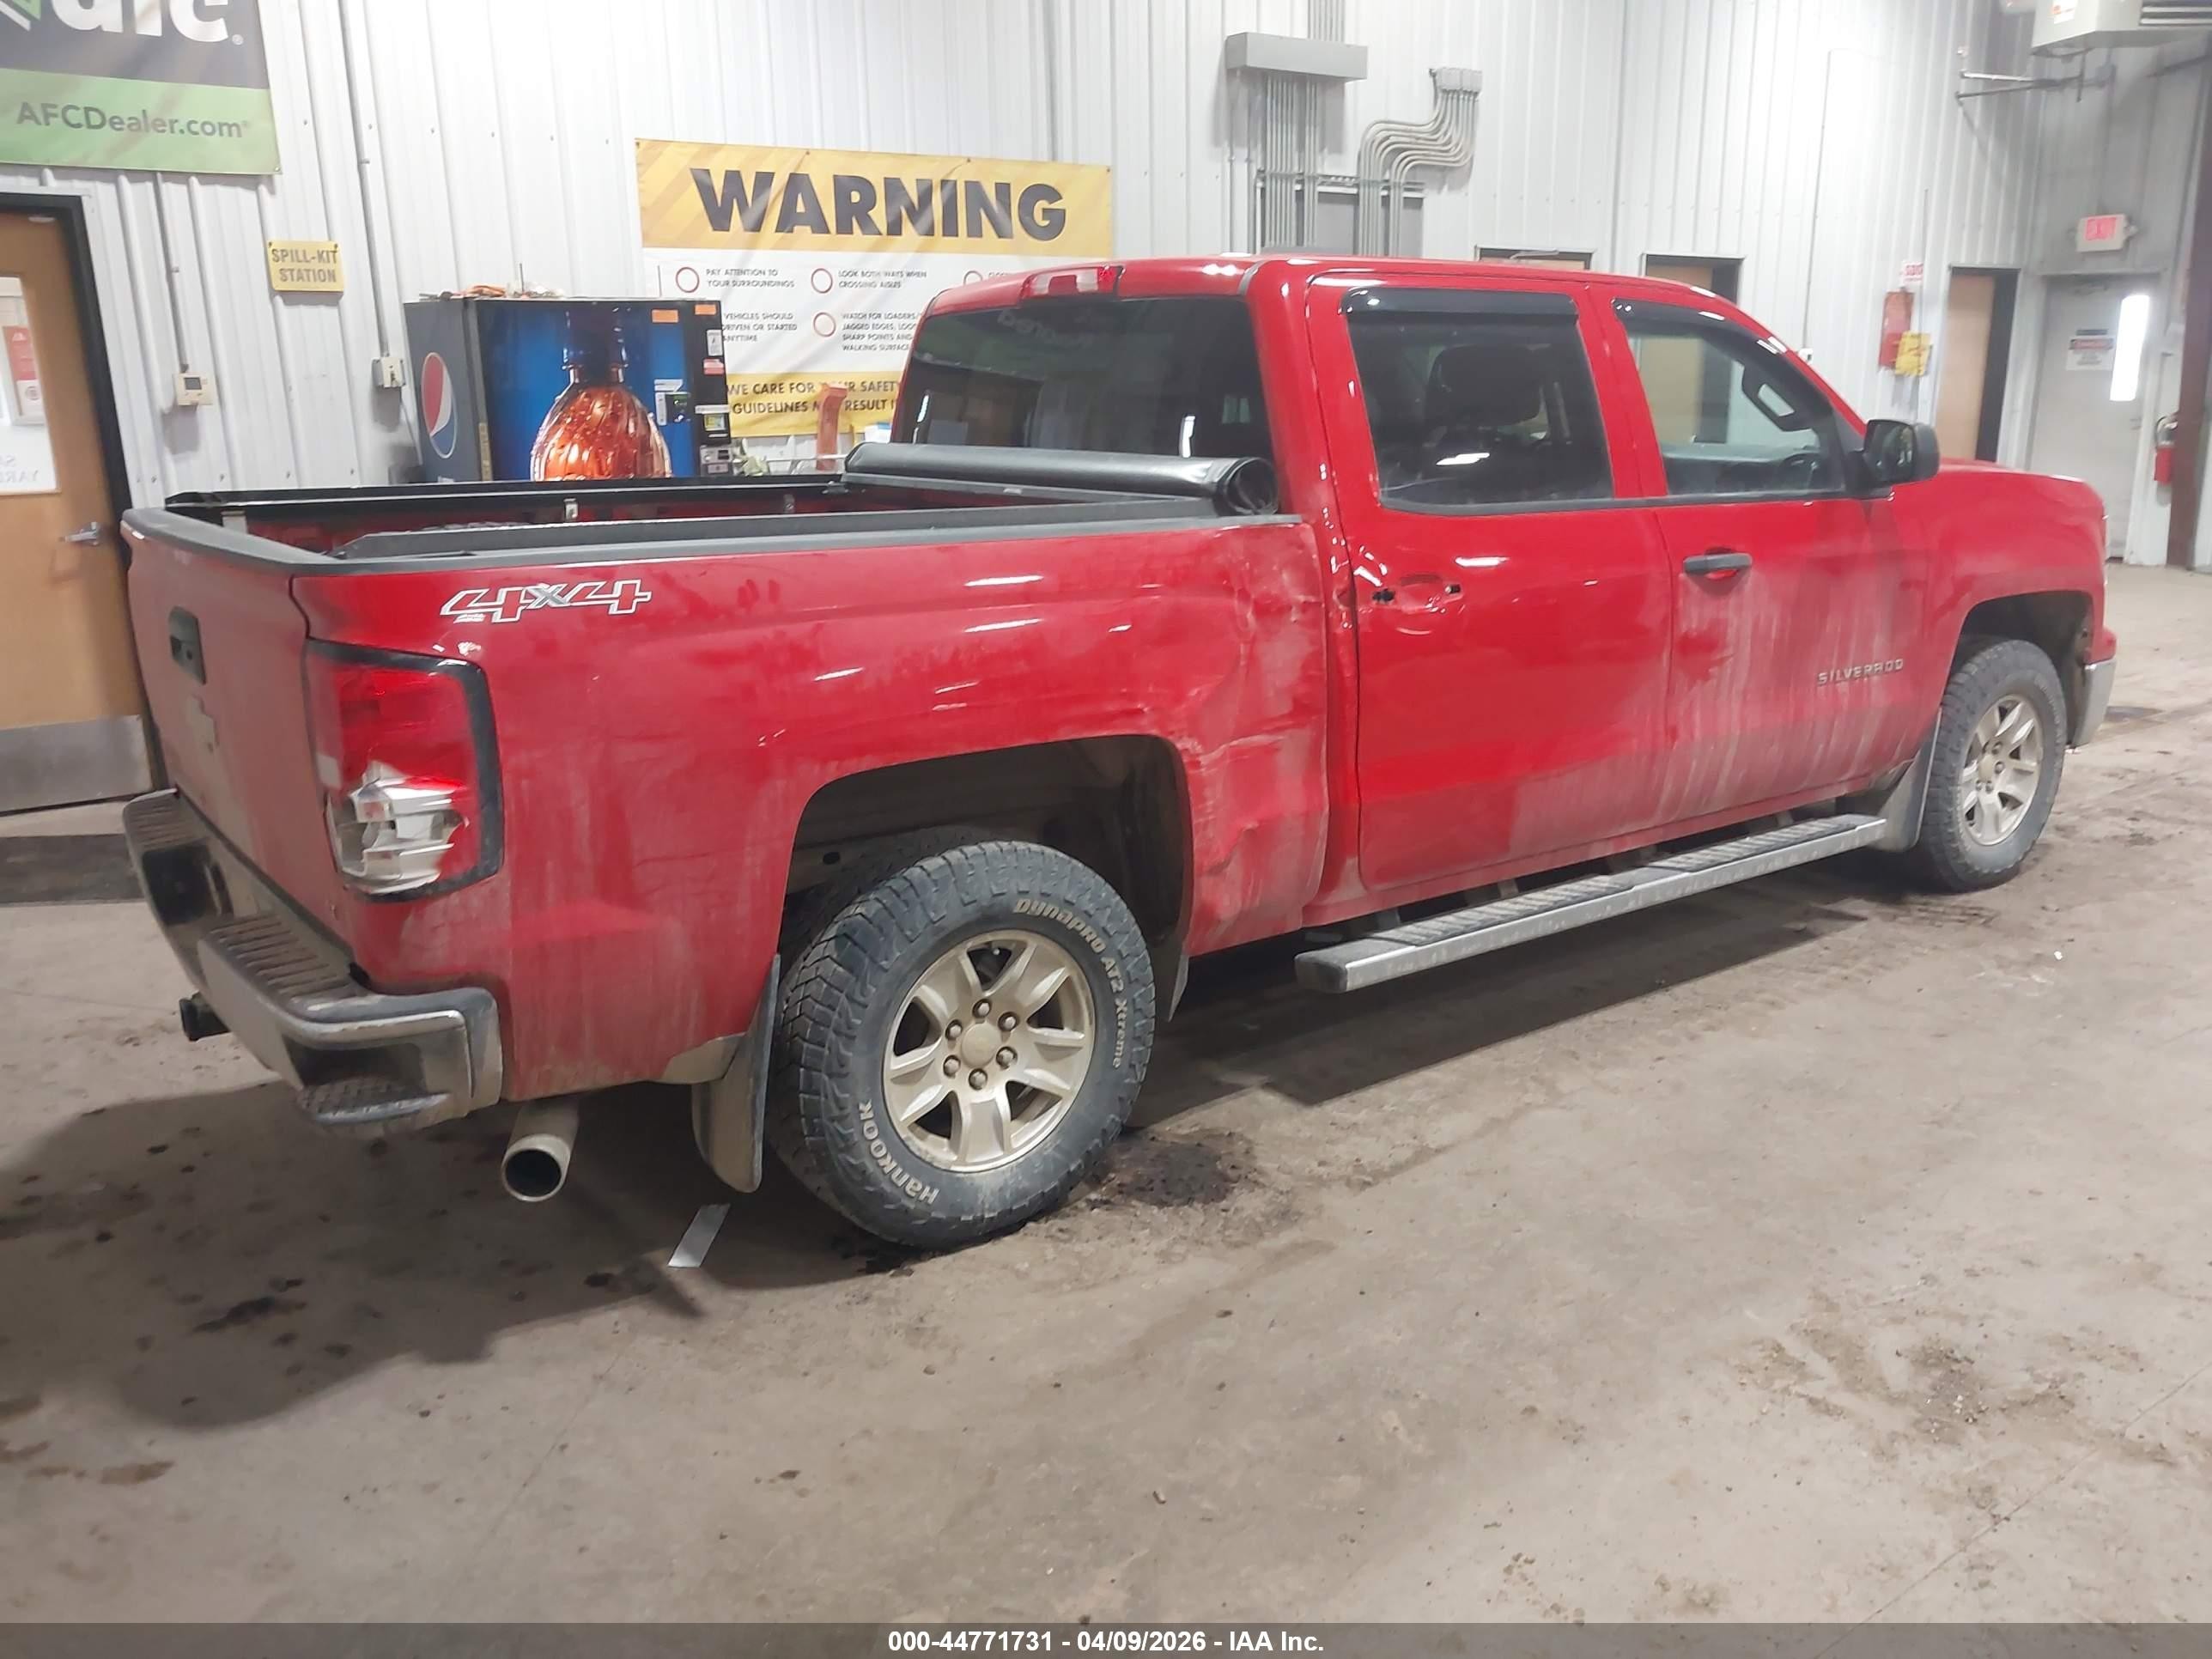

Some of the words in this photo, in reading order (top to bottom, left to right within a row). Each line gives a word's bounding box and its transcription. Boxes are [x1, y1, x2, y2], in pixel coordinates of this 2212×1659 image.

[16, 101, 243, 137] AFCDealer.com
[690, 167, 1066, 241] WARNING
[271, 248, 337, 264] SPILL-KIT
[279, 268, 337, 283] STATION
[728, 384, 749, 396] WE
[752, 382, 784, 395] CARE
[789, 381, 814, 393] FOR
[732, 401, 808, 415] GUIDELINES
[845, 399, 888, 411] RESULT
[1816, 659, 1904, 686] SILVERADO
[1111, 998, 1127, 1069] Xtreme
